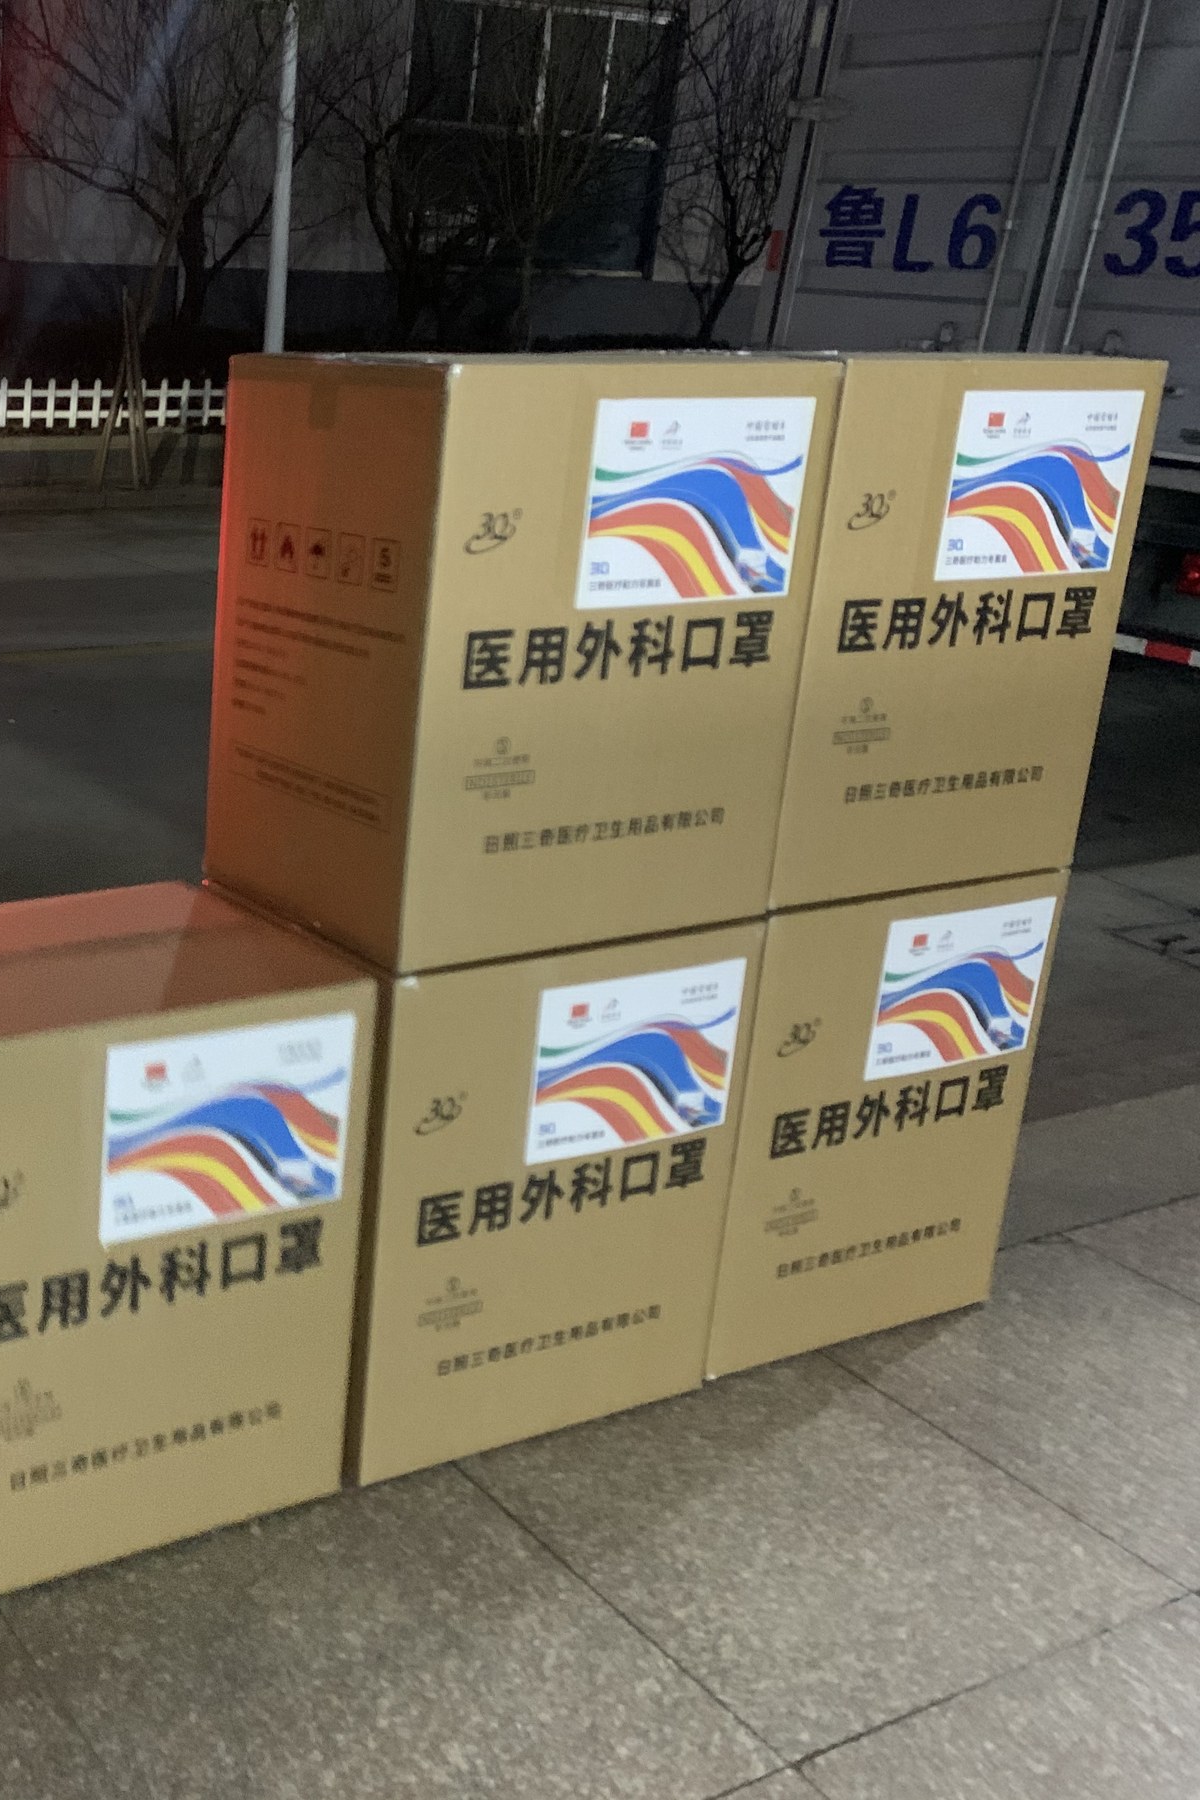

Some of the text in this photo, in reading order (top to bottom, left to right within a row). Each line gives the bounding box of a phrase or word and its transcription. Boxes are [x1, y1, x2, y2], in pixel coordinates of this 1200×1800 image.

[819, 185, 1001, 272] 鲁L6
[462, 610, 774, 690] 医用外科口罩
[838, 587, 1097, 653] 医用外科口罩
[770, 1065, 1009, 1160] 医用外科口罩
[416, 1138, 707, 1247] 医用外科口罩
